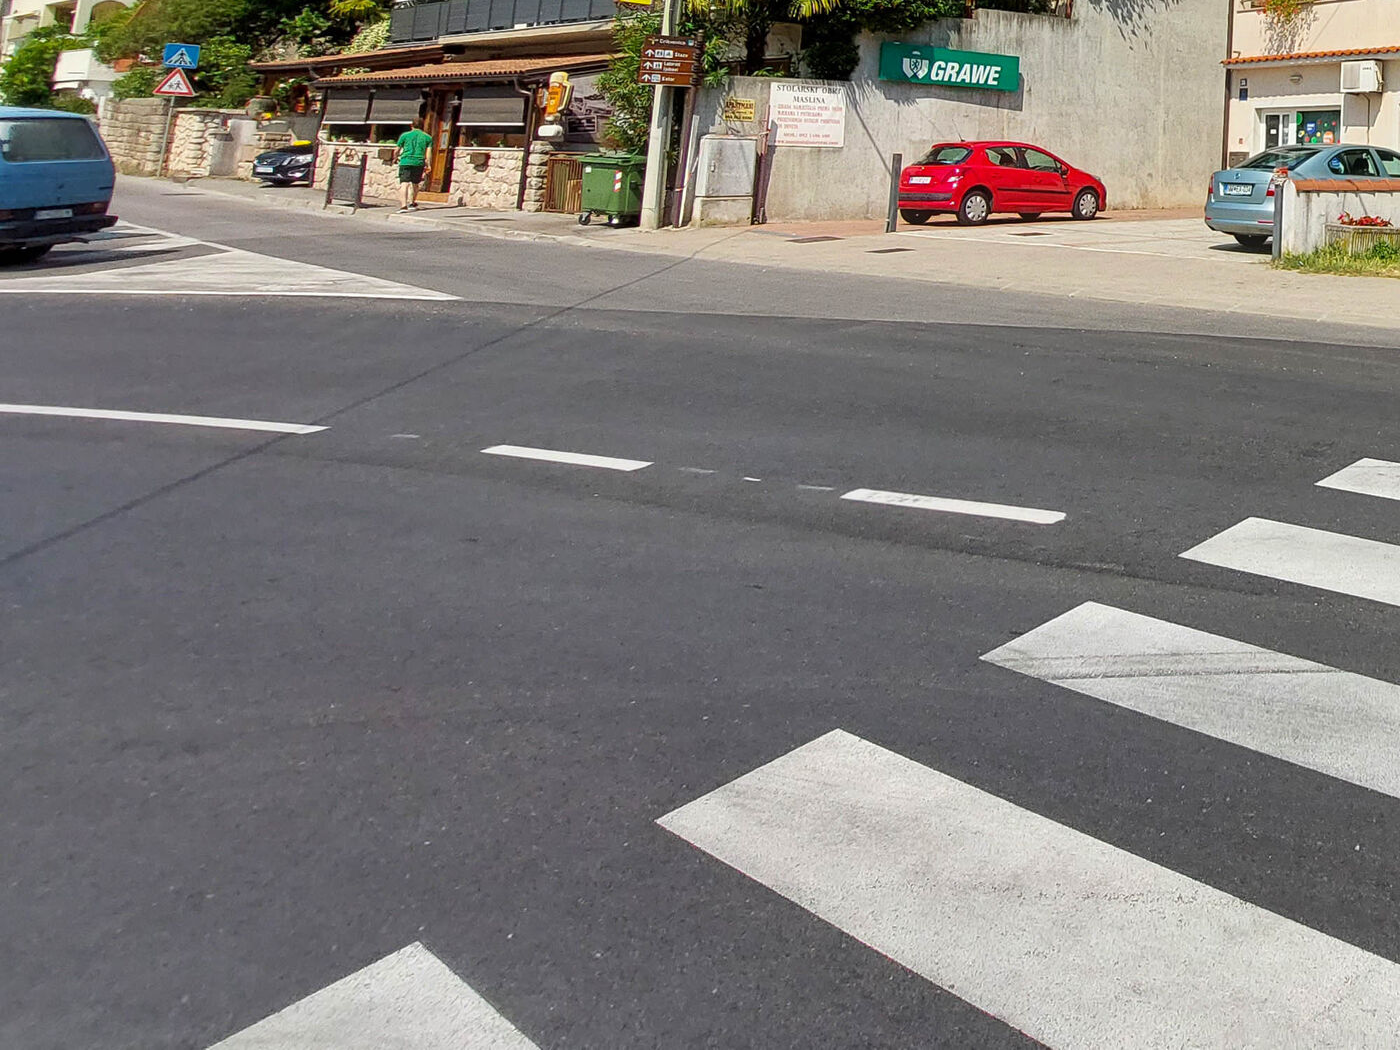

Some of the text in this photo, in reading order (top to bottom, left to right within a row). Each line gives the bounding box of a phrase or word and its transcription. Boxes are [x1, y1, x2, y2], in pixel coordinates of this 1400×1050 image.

[930, 61, 1001, 85] GRAWE
[776, 84, 818, 94] STOLARSKI
[793, 96, 825, 104] MASLINA
